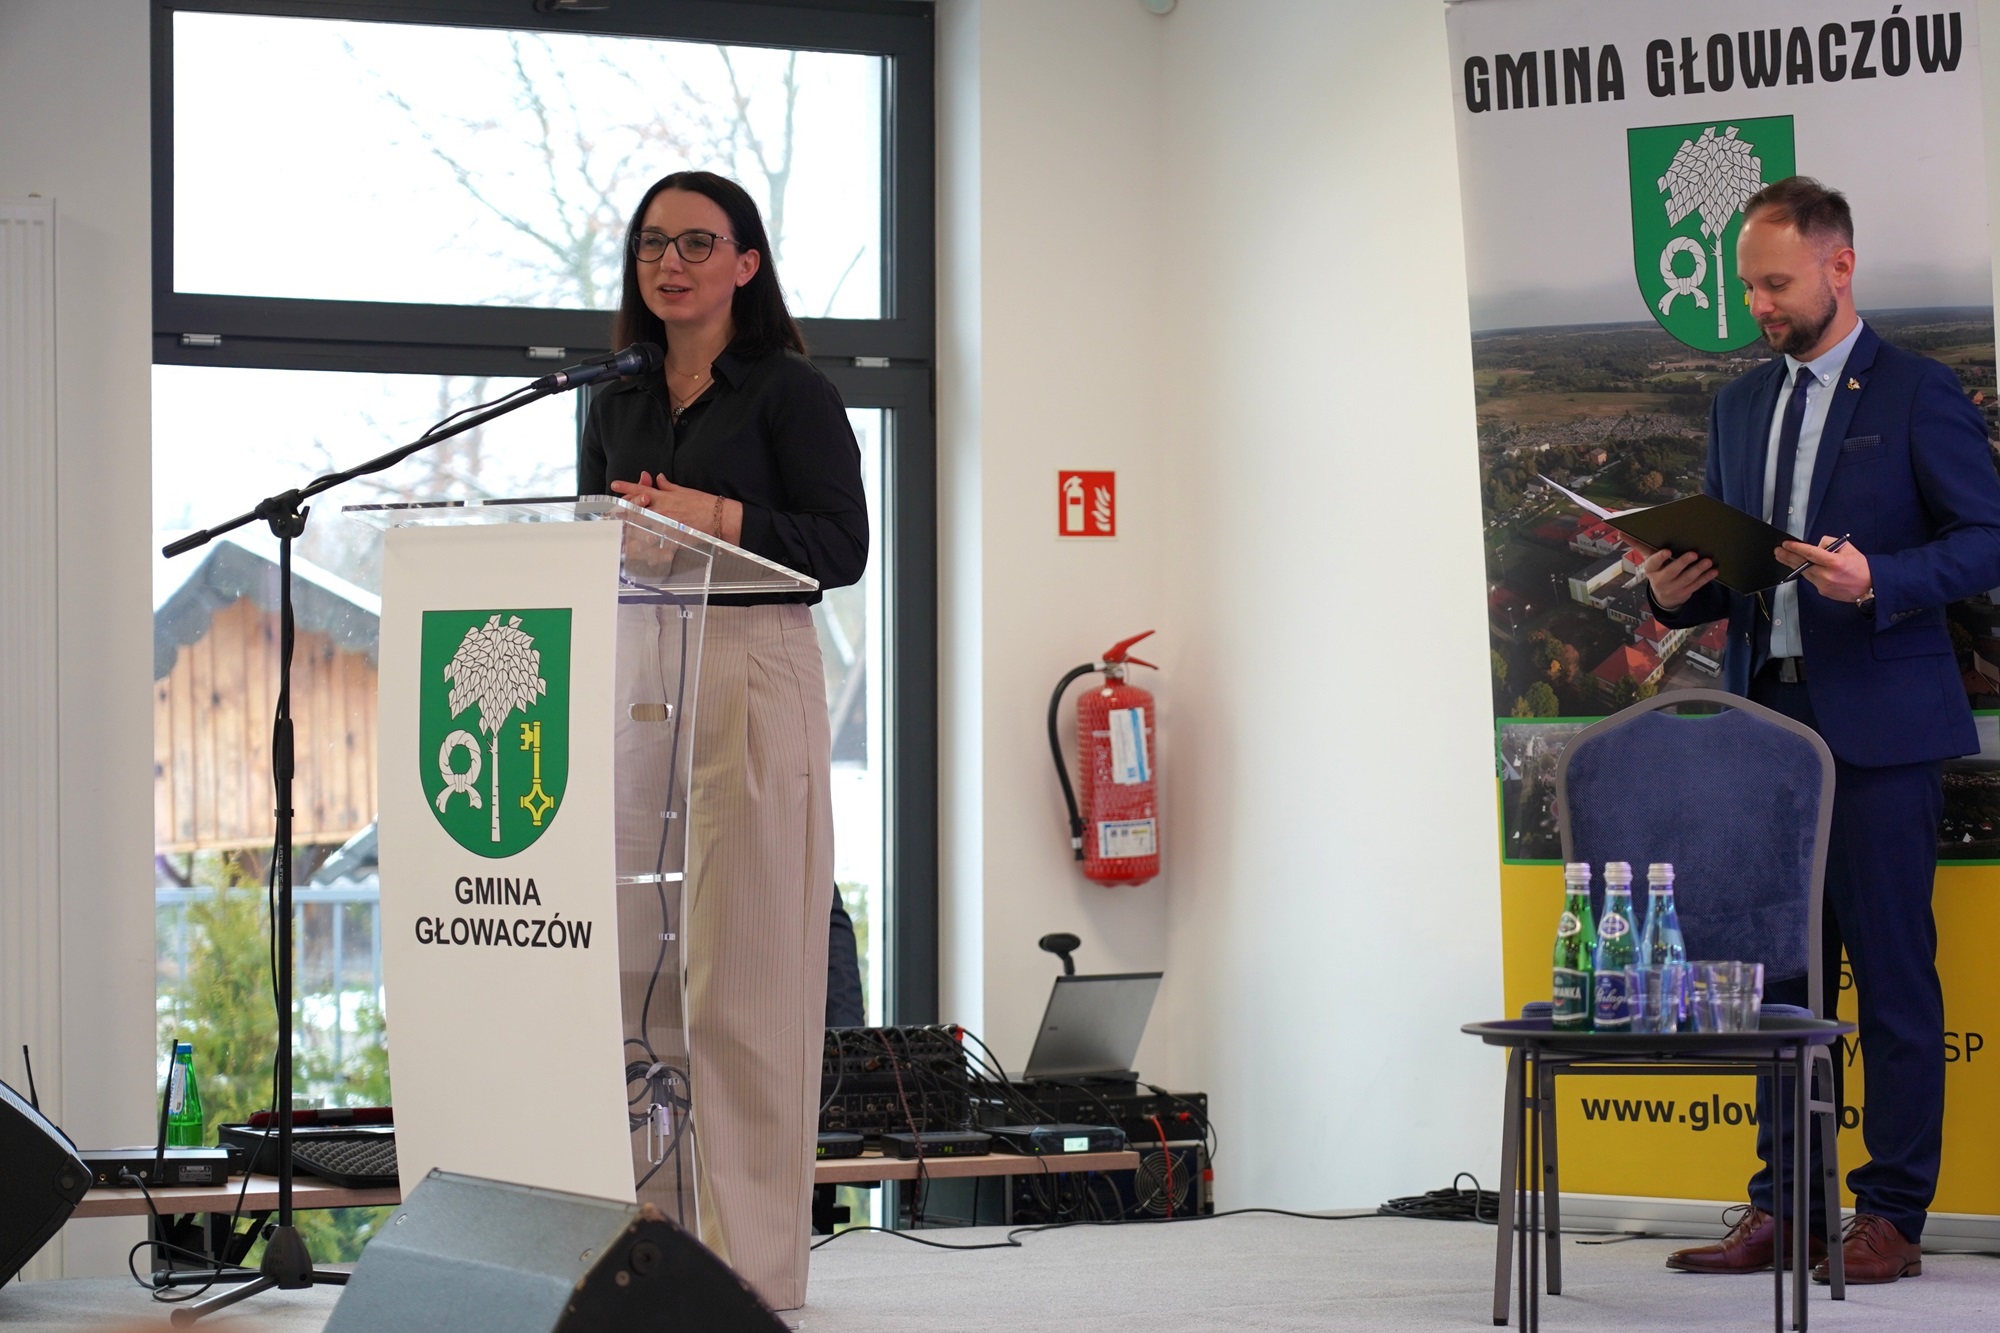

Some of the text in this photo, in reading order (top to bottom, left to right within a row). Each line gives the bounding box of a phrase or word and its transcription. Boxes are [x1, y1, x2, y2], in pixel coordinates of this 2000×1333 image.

[1464, 5, 1962, 113] GMINA GŁOWACZÓW
[455, 876, 541, 906] GMINA
[415, 912, 592, 949] GŁOWACZÓW
